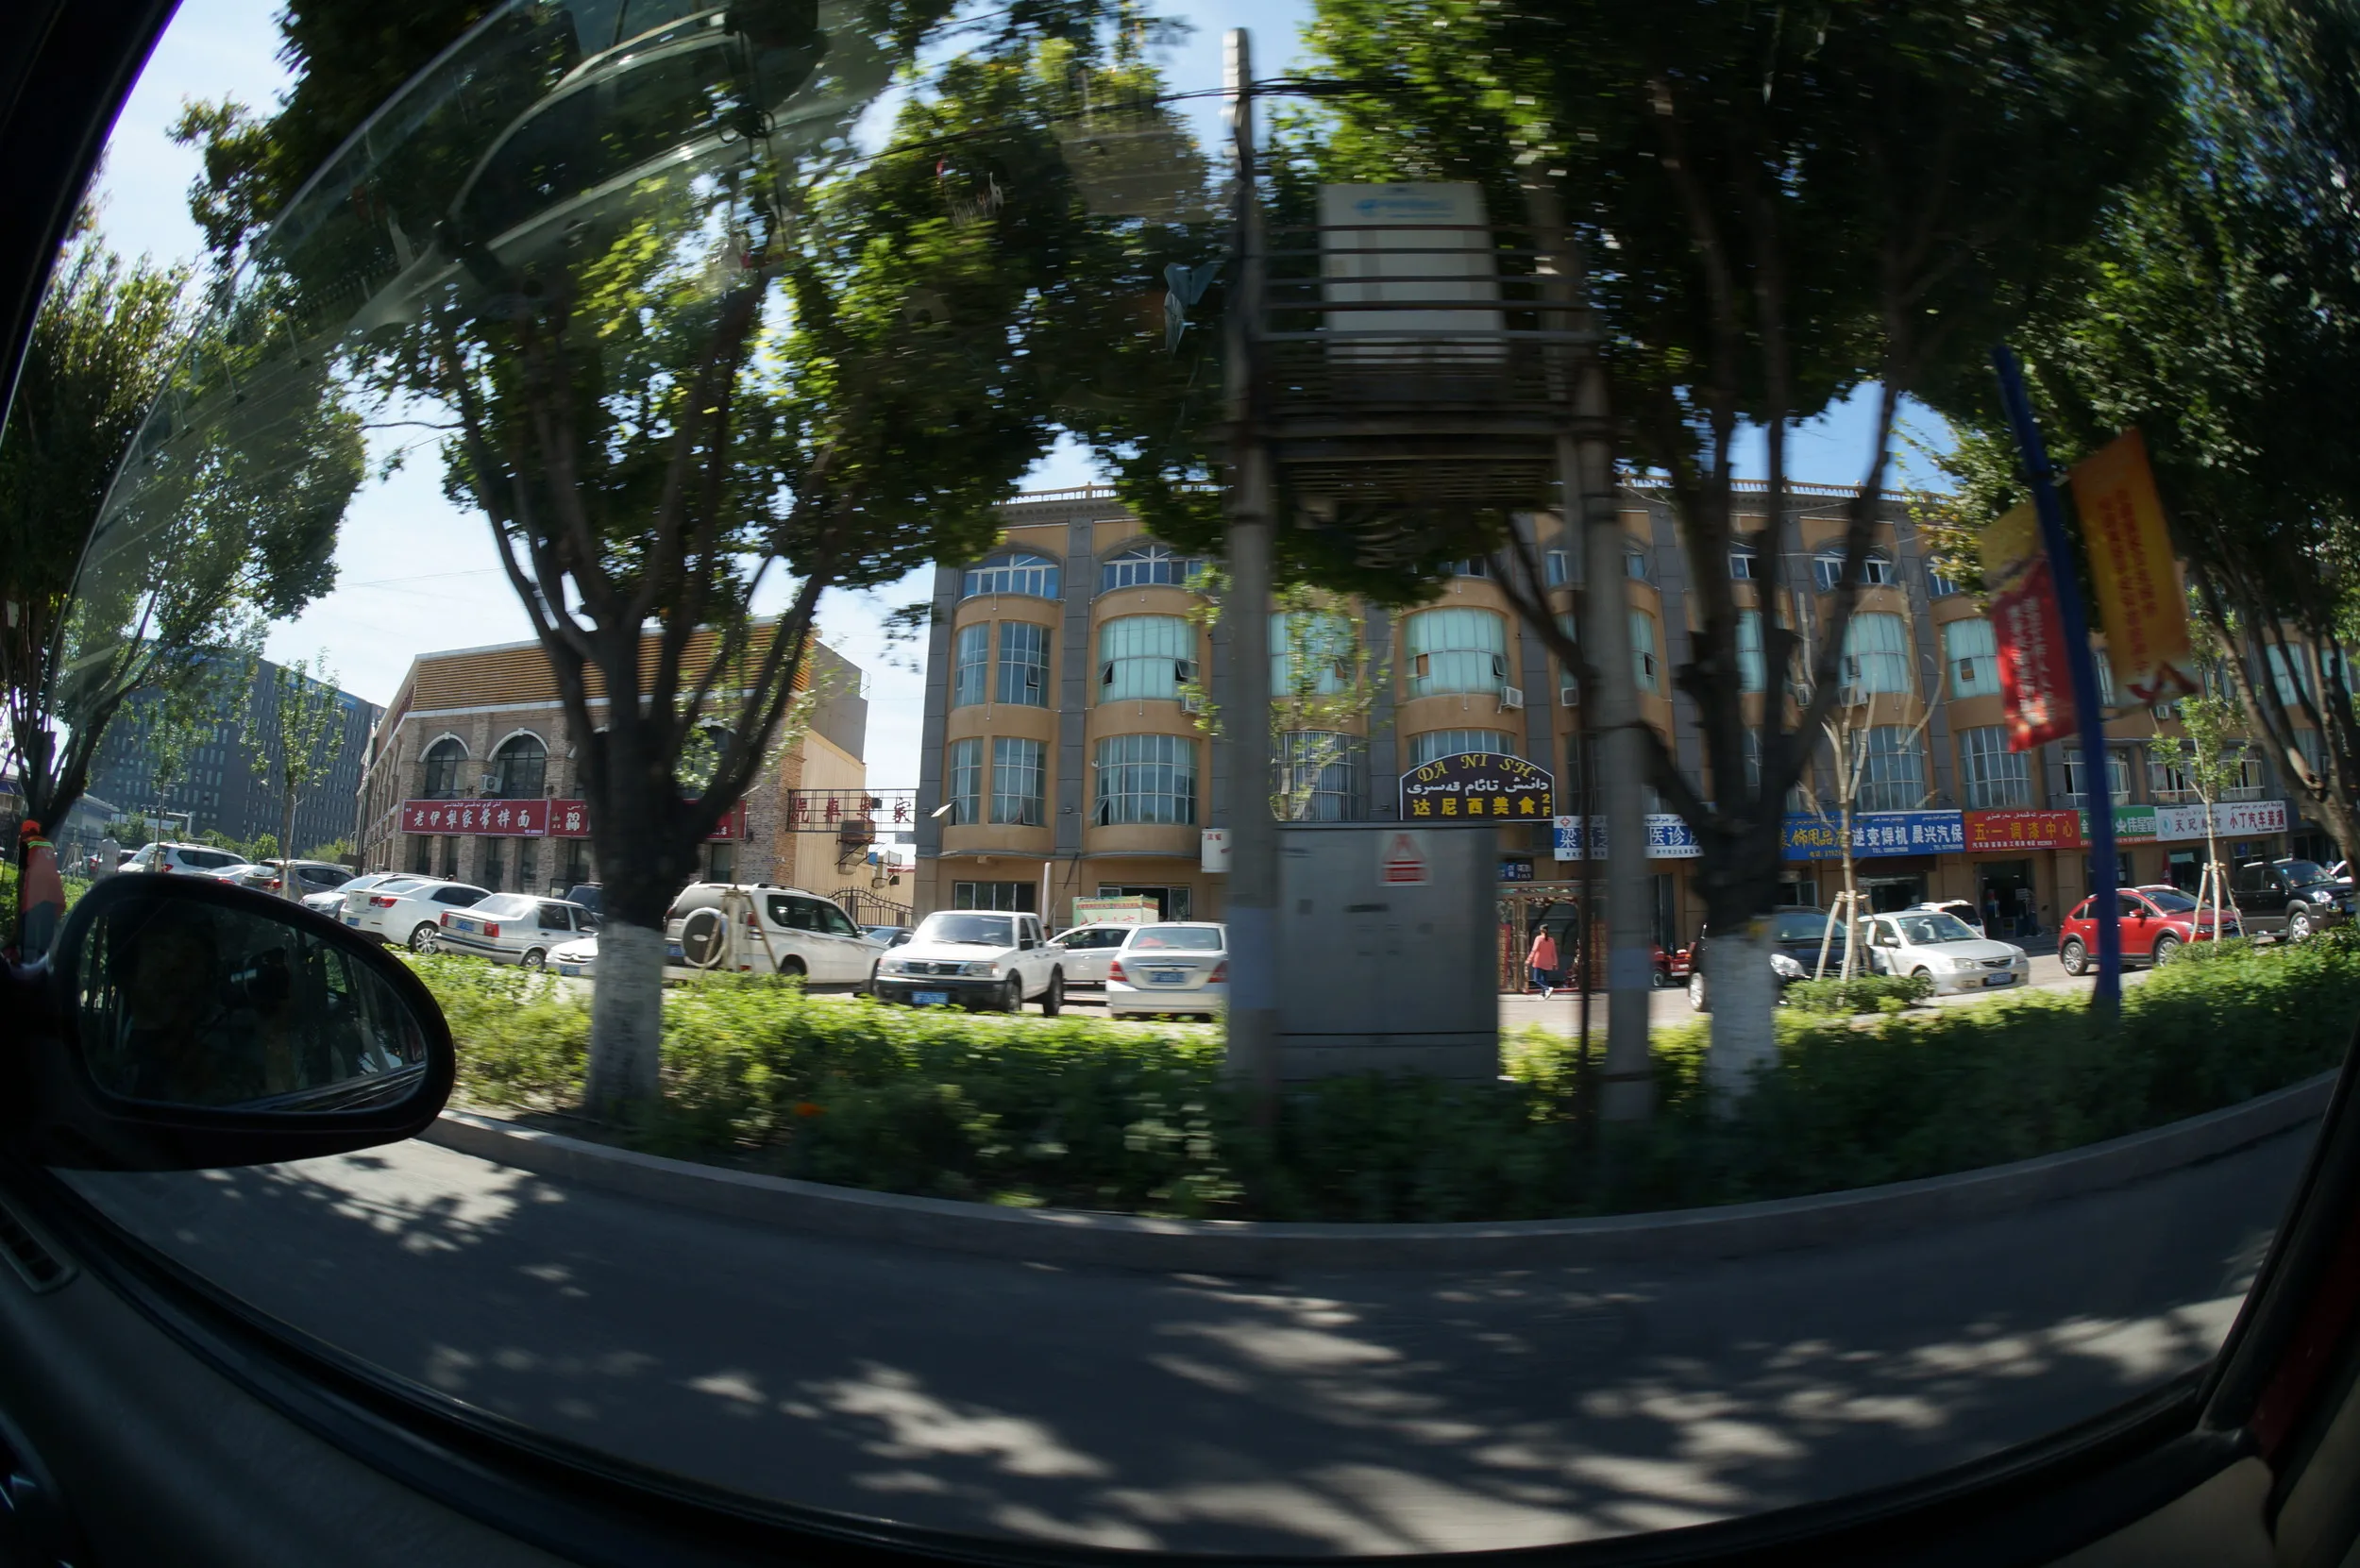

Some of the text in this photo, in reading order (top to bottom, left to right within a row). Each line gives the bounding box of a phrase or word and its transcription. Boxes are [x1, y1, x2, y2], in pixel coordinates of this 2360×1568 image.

[1417, 753, 1537, 783] DA NI SH
[1412, 796, 1536, 816] 达尼西美食
[413, 808, 531, 830] 老伊犁家常拌面
[1851, 823, 1964, 847] 逆变焊机 晨兴汽保
